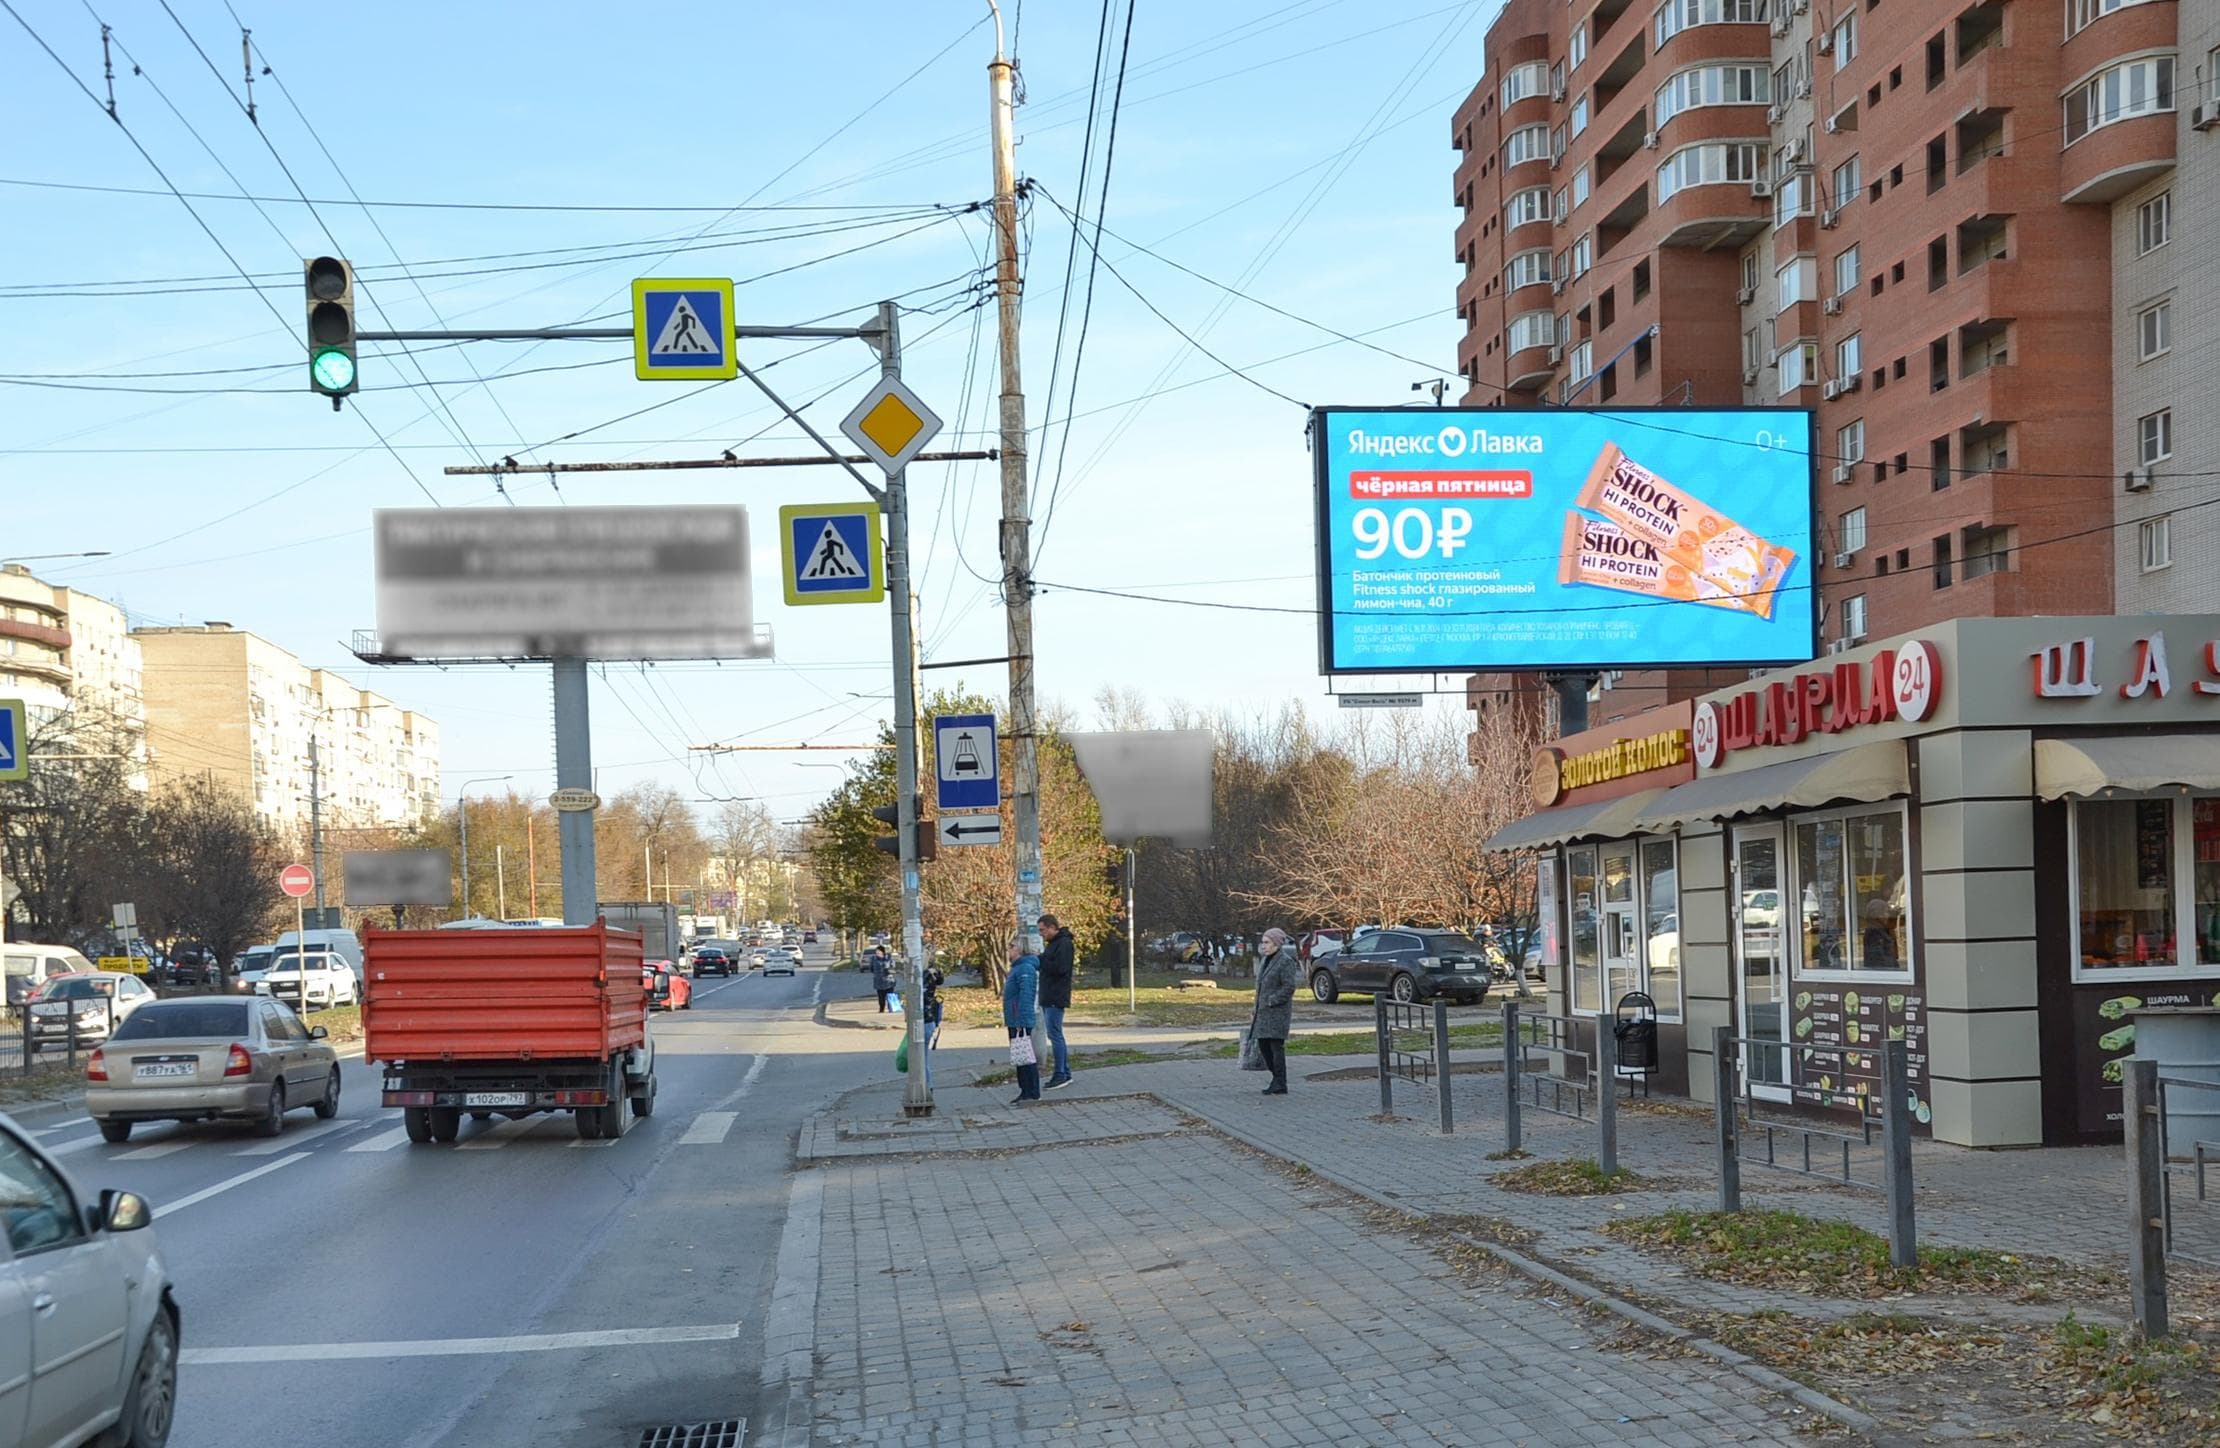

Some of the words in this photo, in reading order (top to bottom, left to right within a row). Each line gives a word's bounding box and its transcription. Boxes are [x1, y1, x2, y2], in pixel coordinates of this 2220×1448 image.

[1348, 429, 1435, 457] Яндекс
[1471, 429, 1543, 454] Лавка
[1756, 430, 1788, 452] 0+
[1356, 477, 1433, 496] чёрная
[1437, 480, 1526, 495] пятница
[1610, 468, 1684, 521] SHOCK
[1604, 488, 1619, 503] HI
[1620, 498, 1674, 535] PROTEIN
[1352, 507, 1472, 559] 90₽
[1583, 532, 1659, 562] SHOCK
[1353, 571, 1412, 582] Батончик
[1416, 570, 1500, 583] протеиновый
[1582, 556, 1596, 567] HI
[1600, 559, 1658, 578] PROTEIN
[1353, 584, 1397, 595] Fitness
[1401, 583, 1436, 594] shock
[1438, 582, 1536, 595] глазированный
[1620, 578, 1656, 590] collagen
[1428, 596, 1445, 608] 40
[1447, 598, 1454, 608] г
[1696, 715, 1713, 753] 24
[1722, 650, 1897, 750] ШАУРМА
[1899, 655, 1925, 703] 24
[1561, 738, 1625, 790] ЗОЛОТОЙ
[1625, 729, 1684, 776] КОЛОС
[2147, 995, 2190, 1005] ШАУРМА
